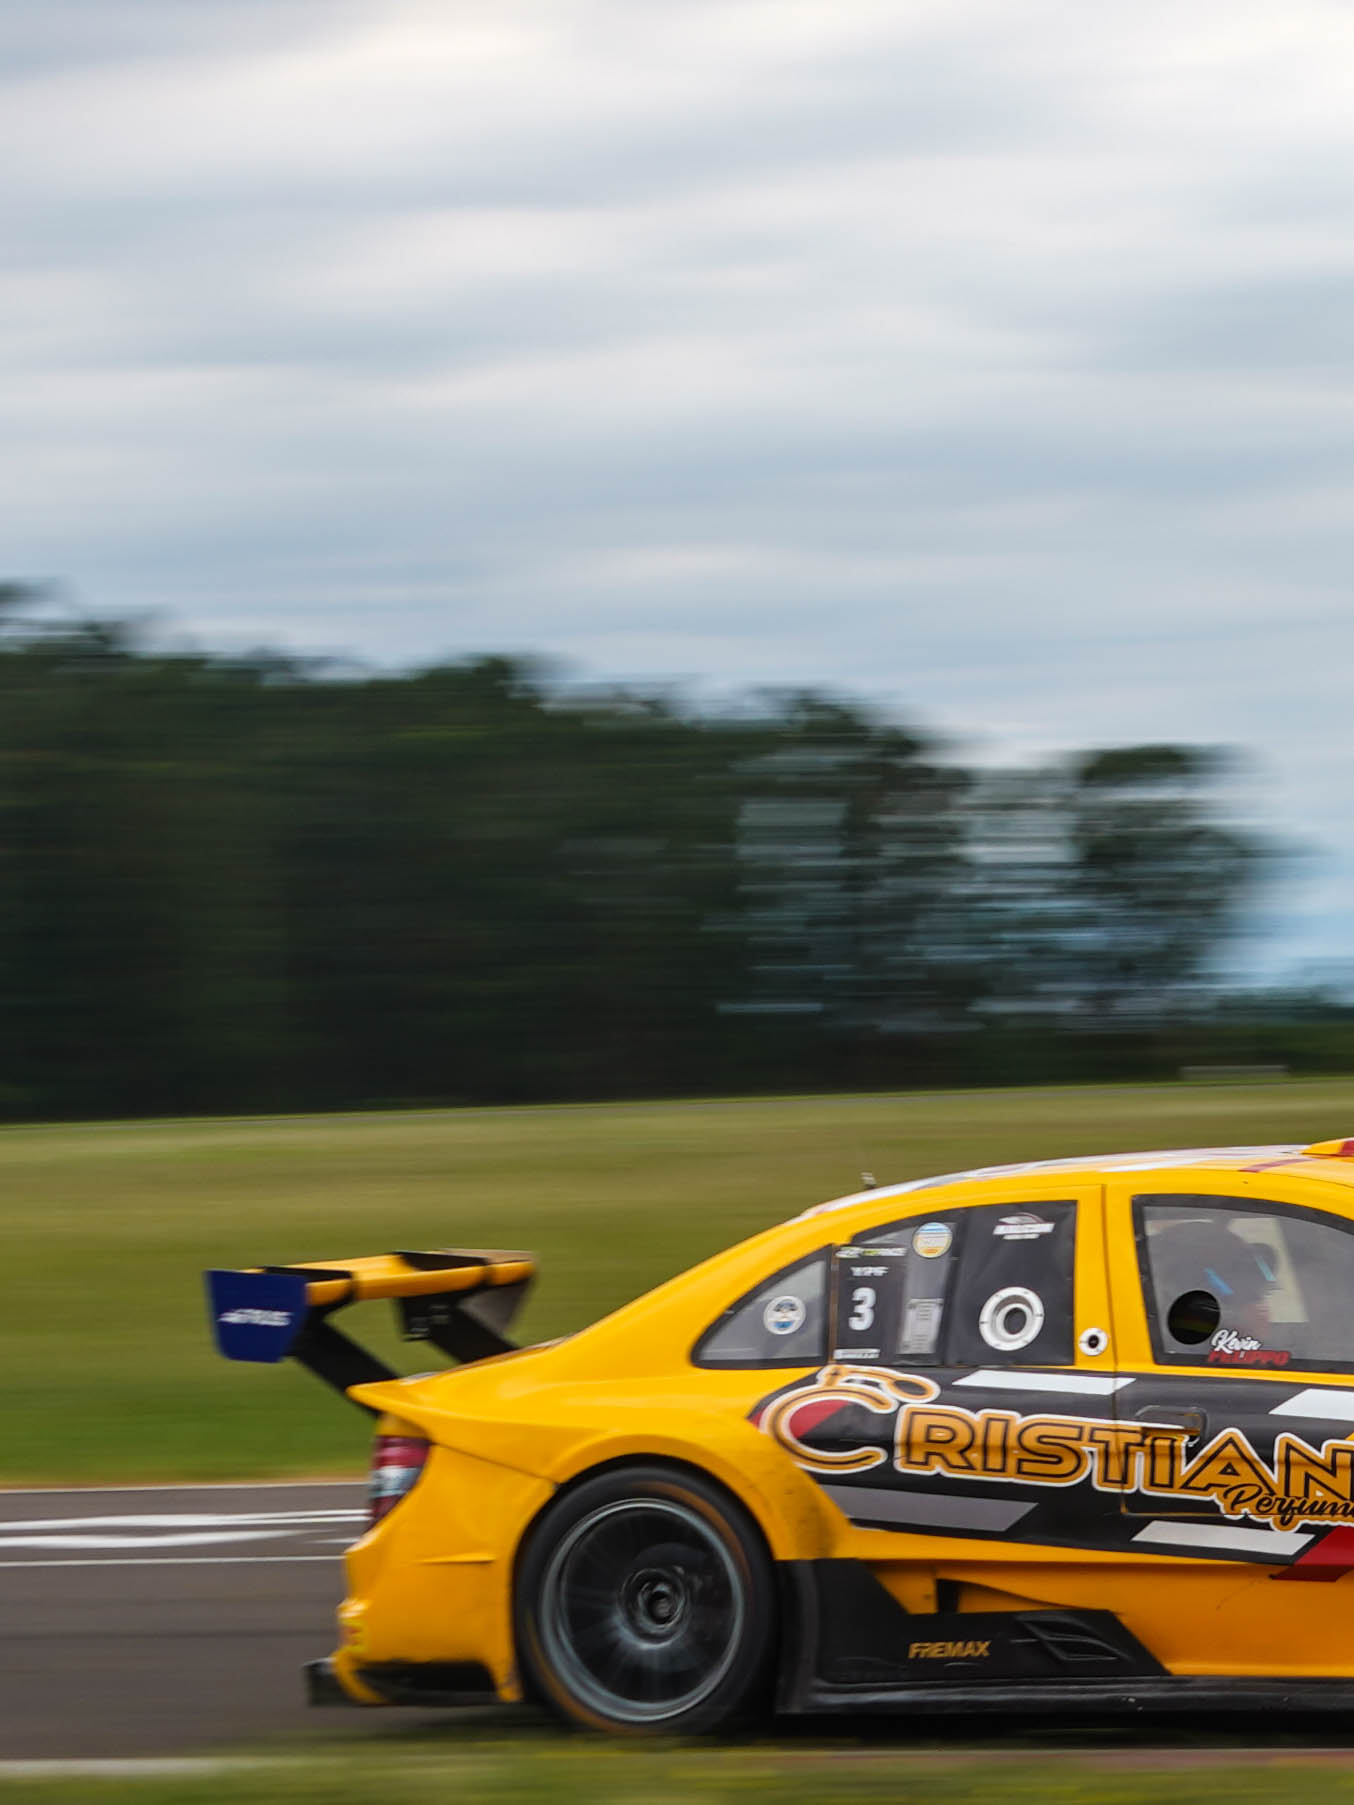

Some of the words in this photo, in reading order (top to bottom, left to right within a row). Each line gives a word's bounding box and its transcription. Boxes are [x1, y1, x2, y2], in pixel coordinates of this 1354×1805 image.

[848, 1286, 876, 1331] 3
[1211, 1328, 1262, 1354] Kevin
[908, 1640, 993, 1659] FREMAX
